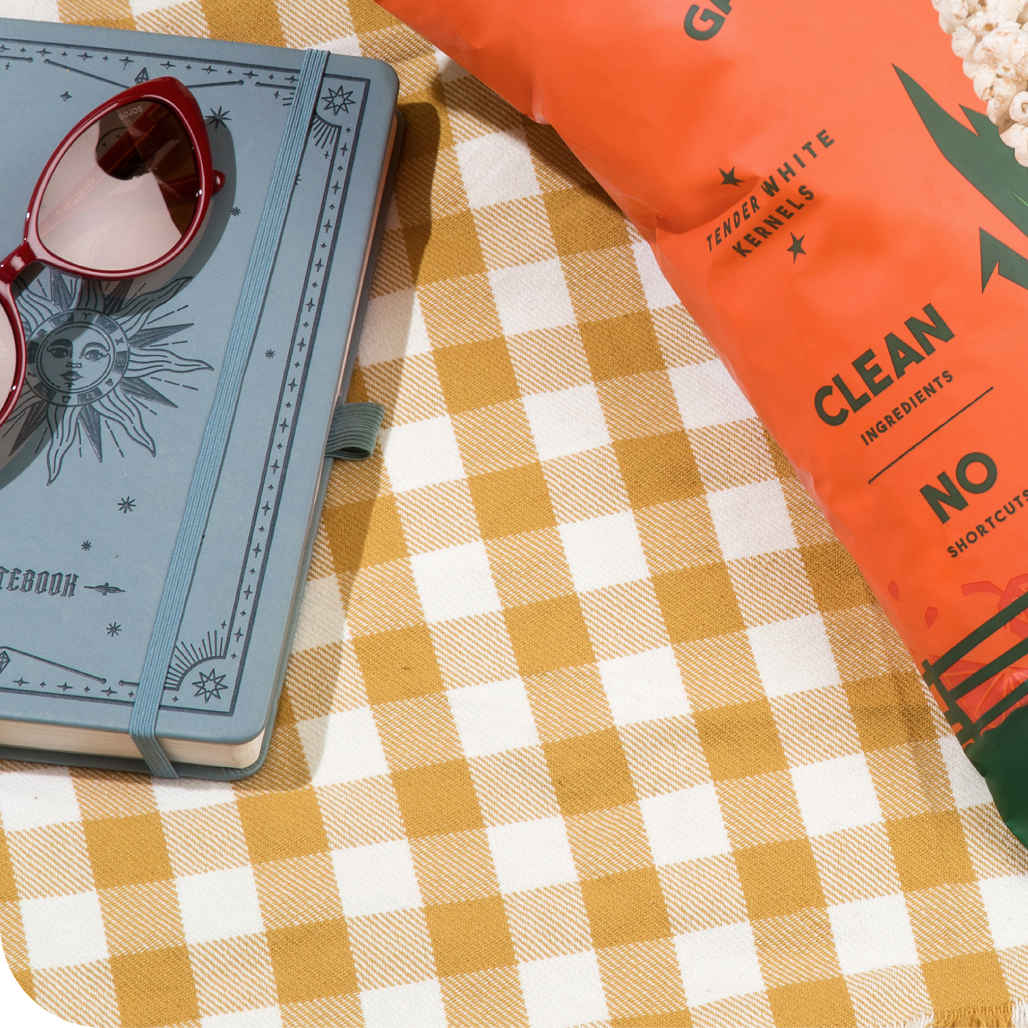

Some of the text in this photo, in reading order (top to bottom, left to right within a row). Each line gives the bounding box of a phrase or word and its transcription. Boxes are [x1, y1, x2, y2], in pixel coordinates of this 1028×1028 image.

[118, 105, 143, 121] SOJOS
[706, 129, 835, 252] TENDER WHITE
[732, 185, 814, 258] KERNELS
[815, 303, 955, 426] CLEAN
[861, 370, 953, 445] INGREDIENTS
[920, 452, 997, 524] NO
